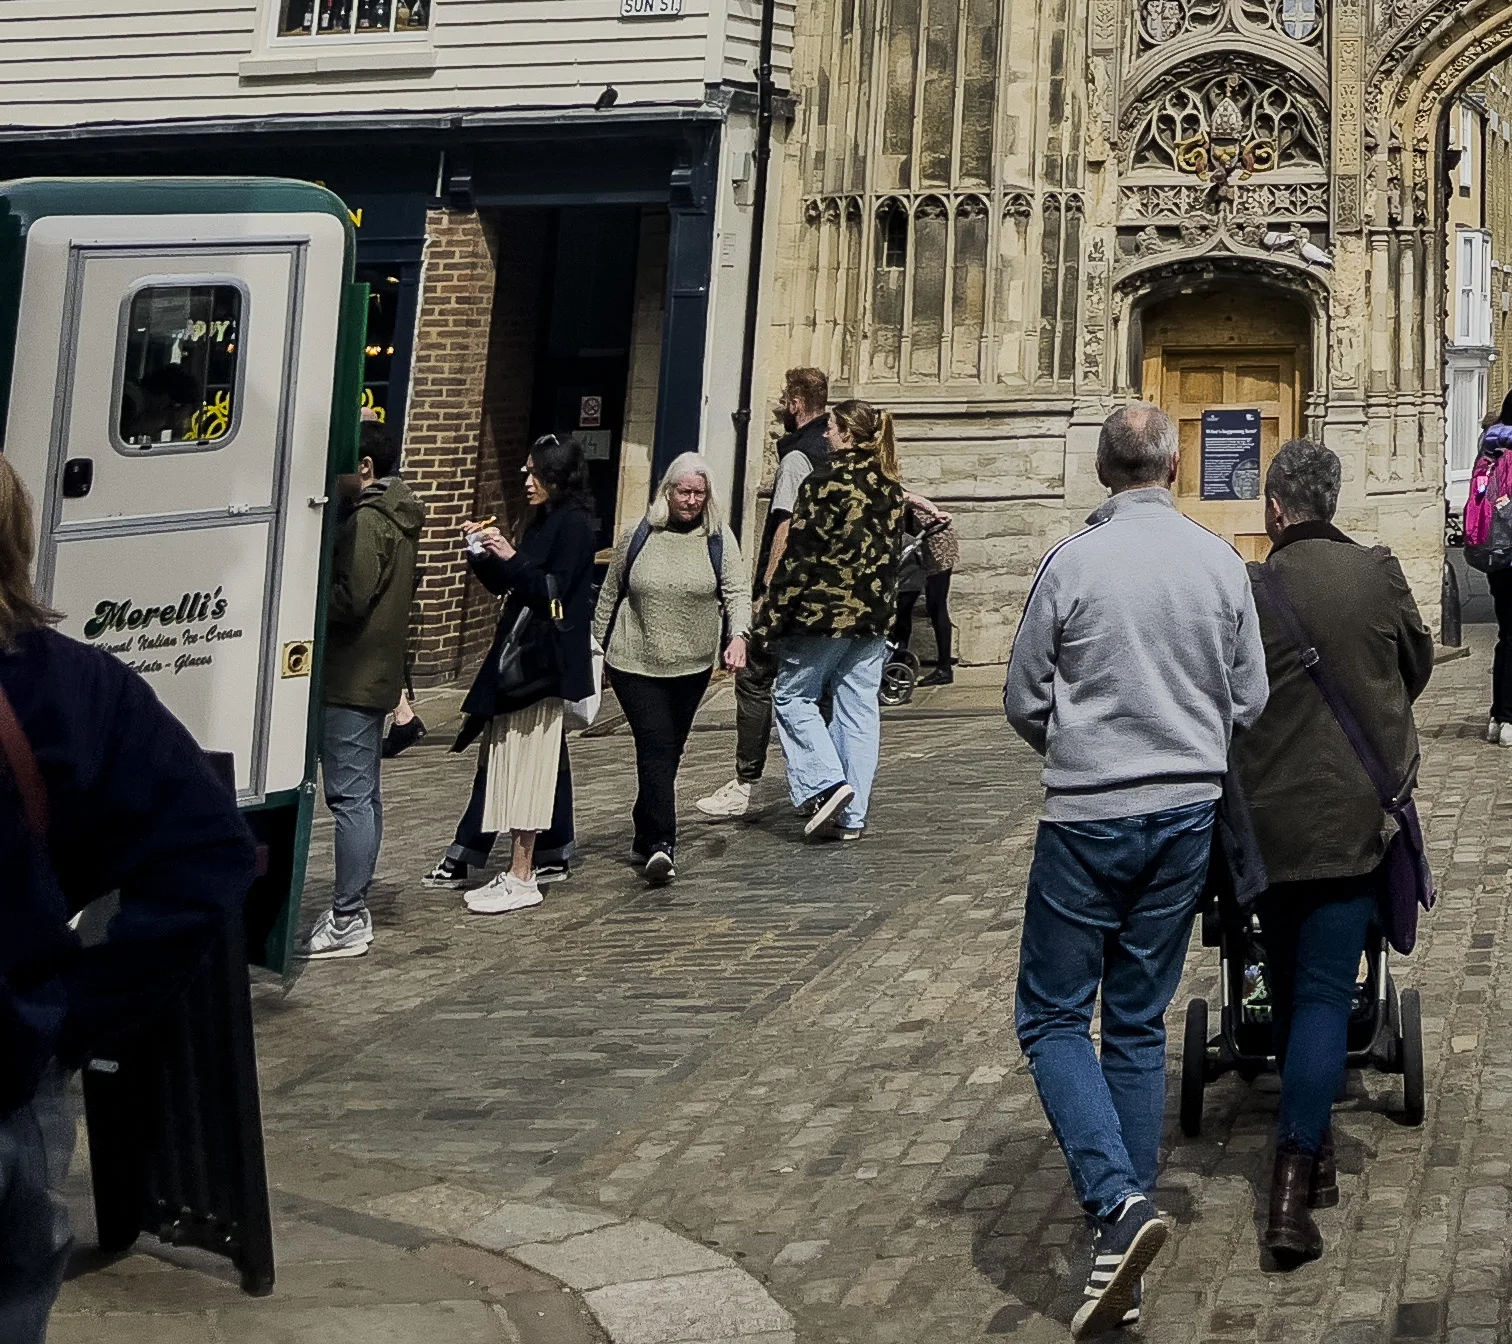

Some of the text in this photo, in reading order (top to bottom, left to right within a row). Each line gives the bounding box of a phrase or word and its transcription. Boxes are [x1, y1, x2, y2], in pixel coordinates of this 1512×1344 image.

[84, 585, 228, 640] Morelli's
[137, 632, 178, 652] Italian
[182, 623, 243, 646] Ice-Cream
